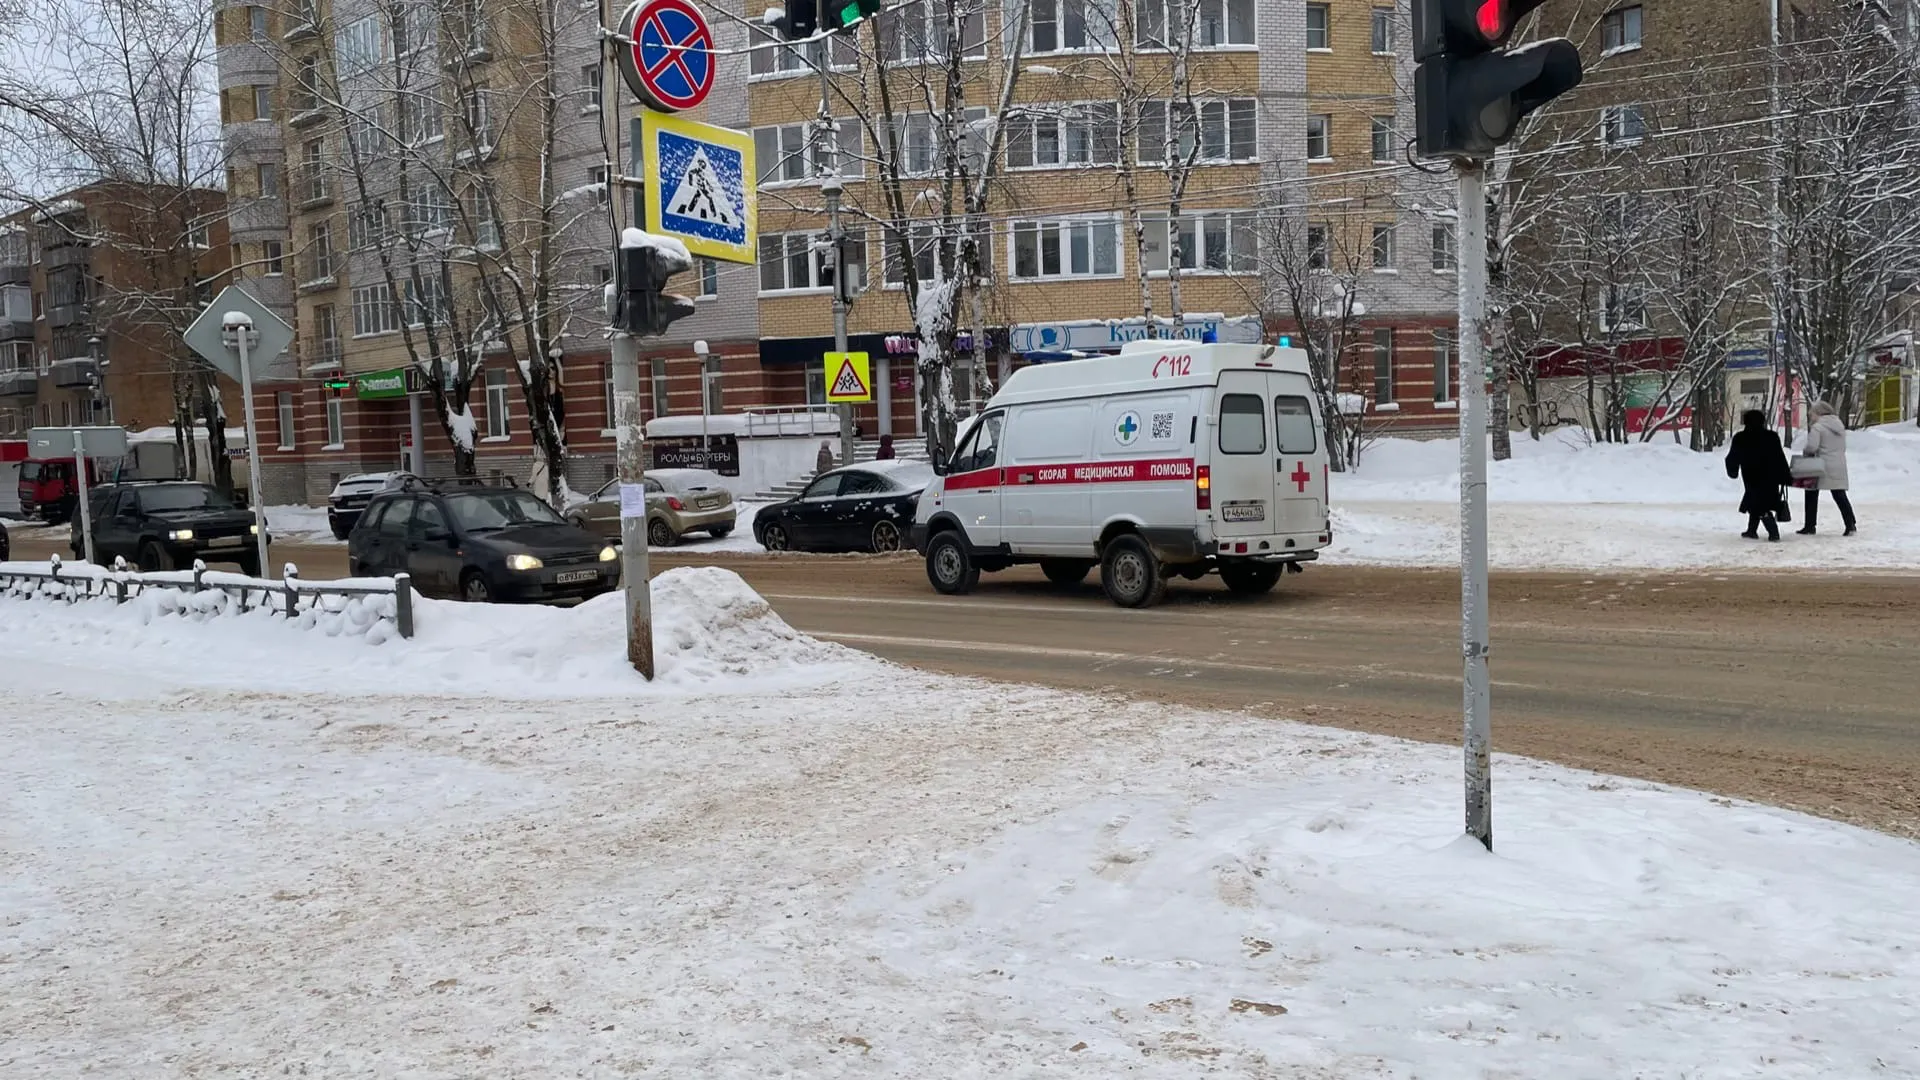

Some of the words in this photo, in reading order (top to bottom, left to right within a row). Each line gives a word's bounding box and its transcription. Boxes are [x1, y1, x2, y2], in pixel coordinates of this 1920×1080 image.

[1169, 355, 1191, 376] 112
[660, 453, 690, 463] РОЛЛЫ
[1038, 468, 1067, 481] СКОРАЯ
[1074, 465, 1134, 481] МЕДИЦИНСКАЯ
[1150, 462, 1192, 478] ПОМОЩЬ
